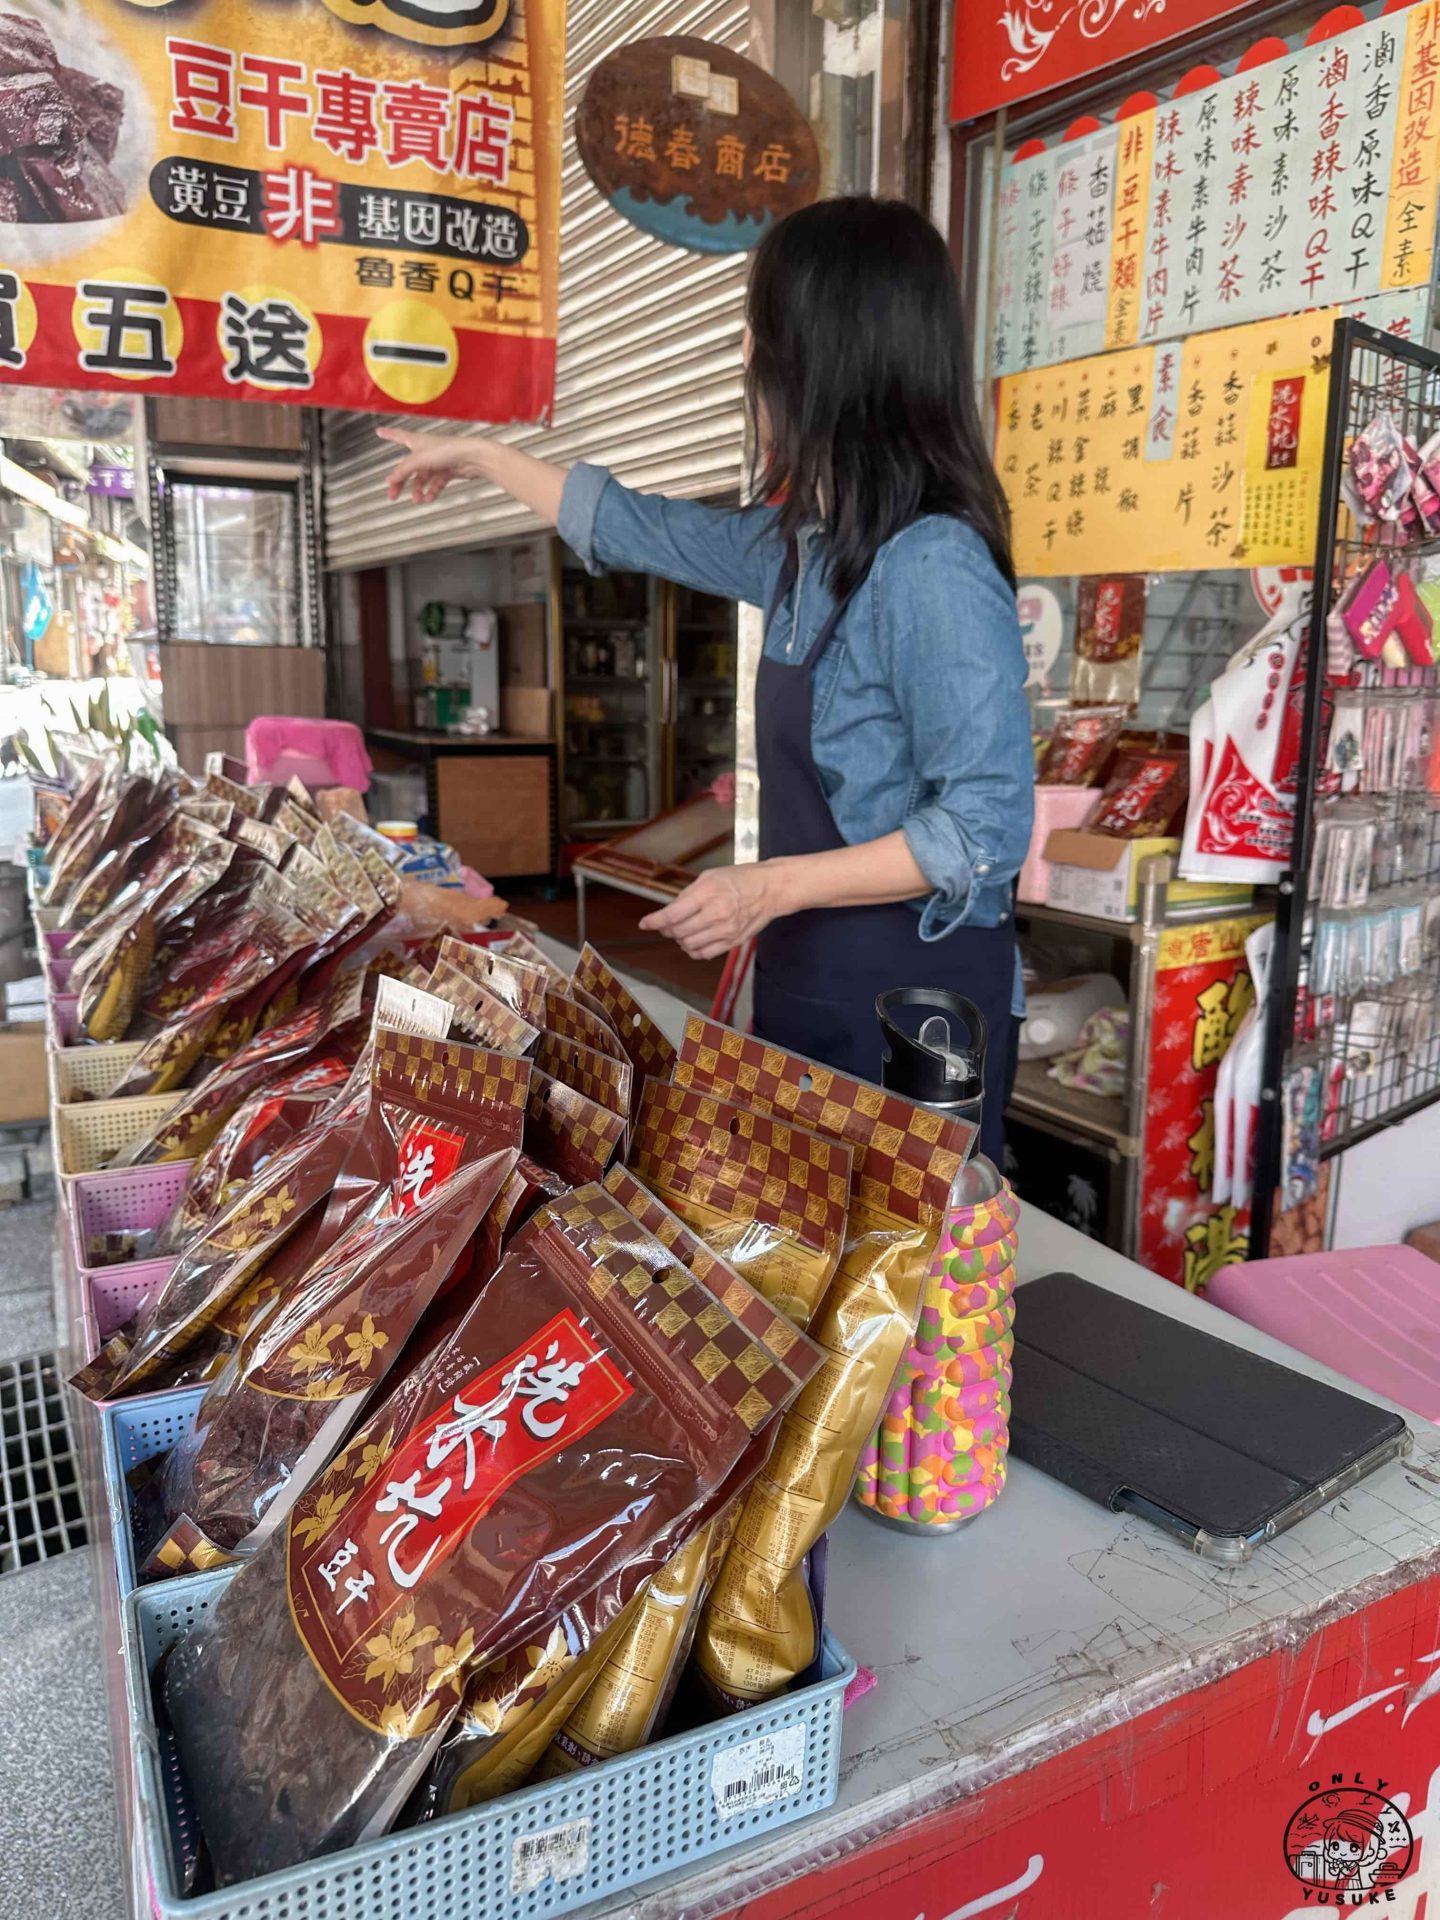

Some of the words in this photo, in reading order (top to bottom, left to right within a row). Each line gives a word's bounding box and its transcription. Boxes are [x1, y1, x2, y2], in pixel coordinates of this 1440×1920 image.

[166, 38, 515, 185] 豆干專賣店
[614, 114, 792, 184] 德春商店
[1217, 80, 1266, 303] 辣味素沙茶
[1257, 64, 1300, 294] 原味素沙茶
[1300, 46, 1350, 299] 滷香辣味Q干
[1343, 30, 1396, 290] 滷香原味Q干
[1143, 109, 1184, 338] 辣味素牛肉片
[1178, 92, 1220, 327] 原味素牛肉片
[0, 268, 451, 389] 五送一
[1149, 352, 1175, 442] 素食
[1117, 384, 1144, 512] 黑胡椒
[1174, 379, 1206, 526] 香蒜片
[1205, 370, 1244, 548] 香蒜沙茶
[375, 1339, 586, 1589] 洗水坑
[317, 1537, 377, 1616] 豆干
